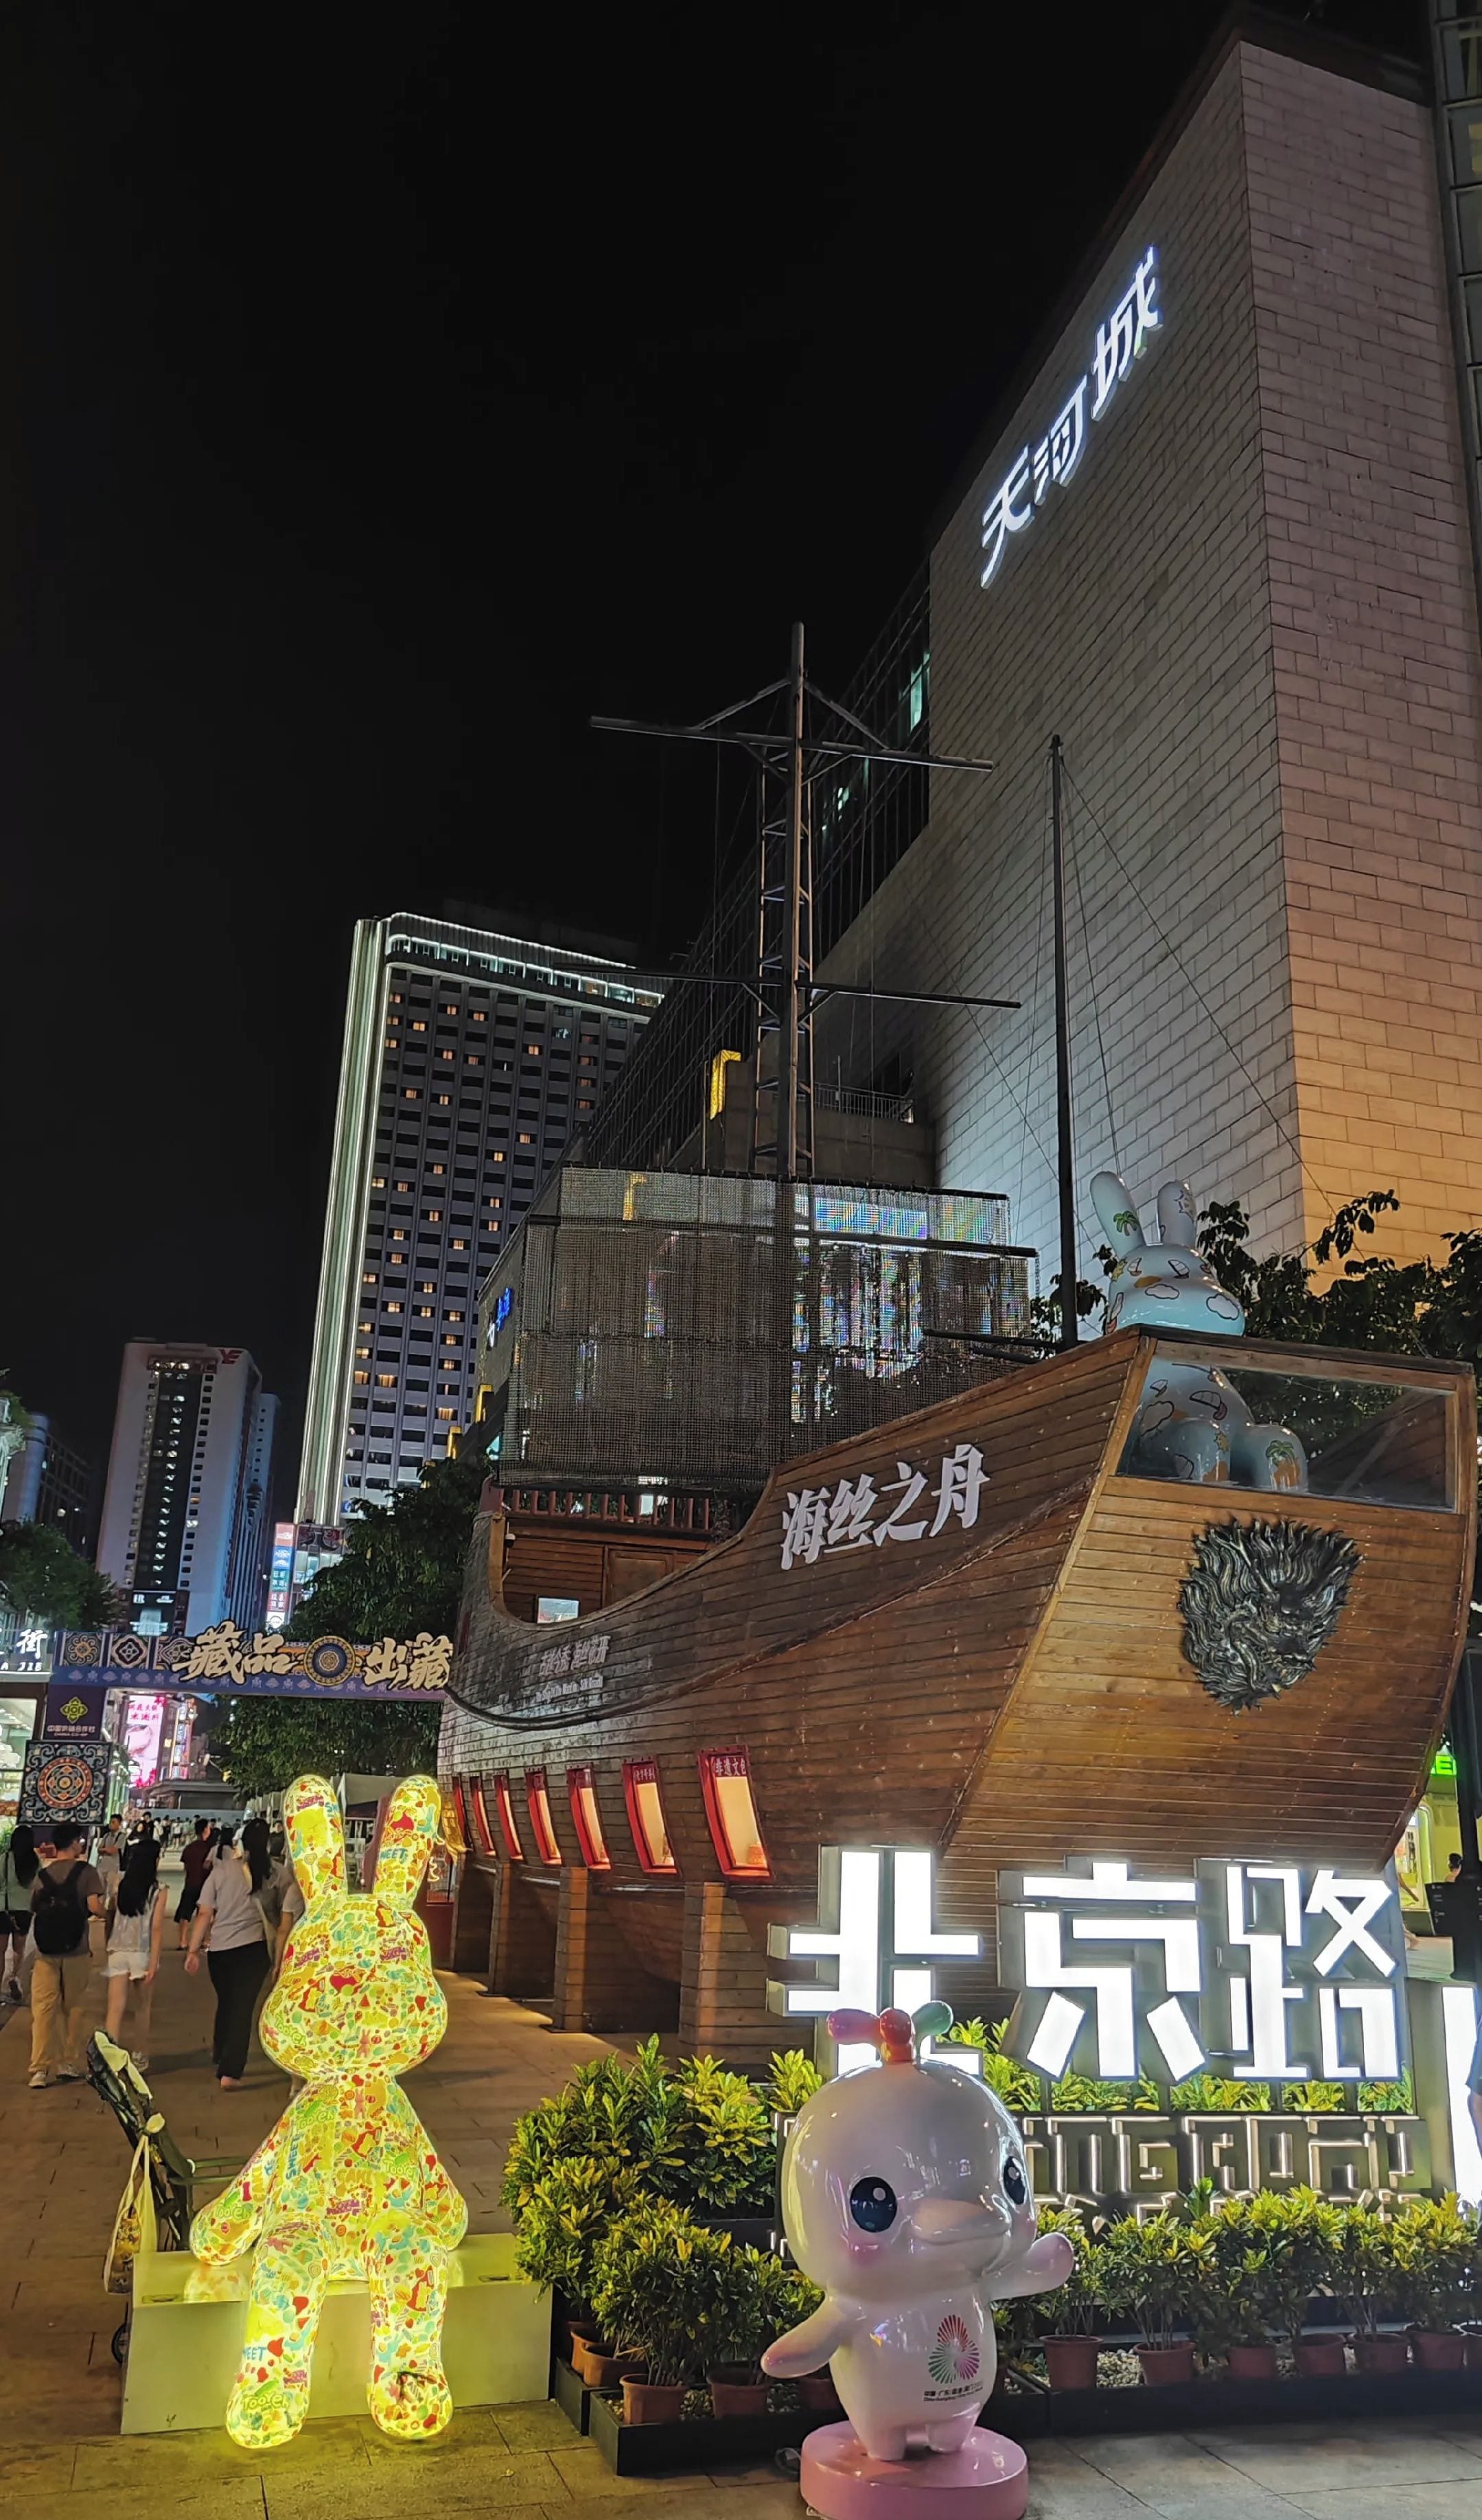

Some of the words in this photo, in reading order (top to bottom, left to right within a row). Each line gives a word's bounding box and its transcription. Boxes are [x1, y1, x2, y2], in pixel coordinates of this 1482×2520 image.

[980, 243, 1163, 589] 天河城
[780, 1443, 991, 1571] 海丝之舟
[0, 1628, 47, 1659] 街
[783, 1847, 1401, 2084] 北京路
